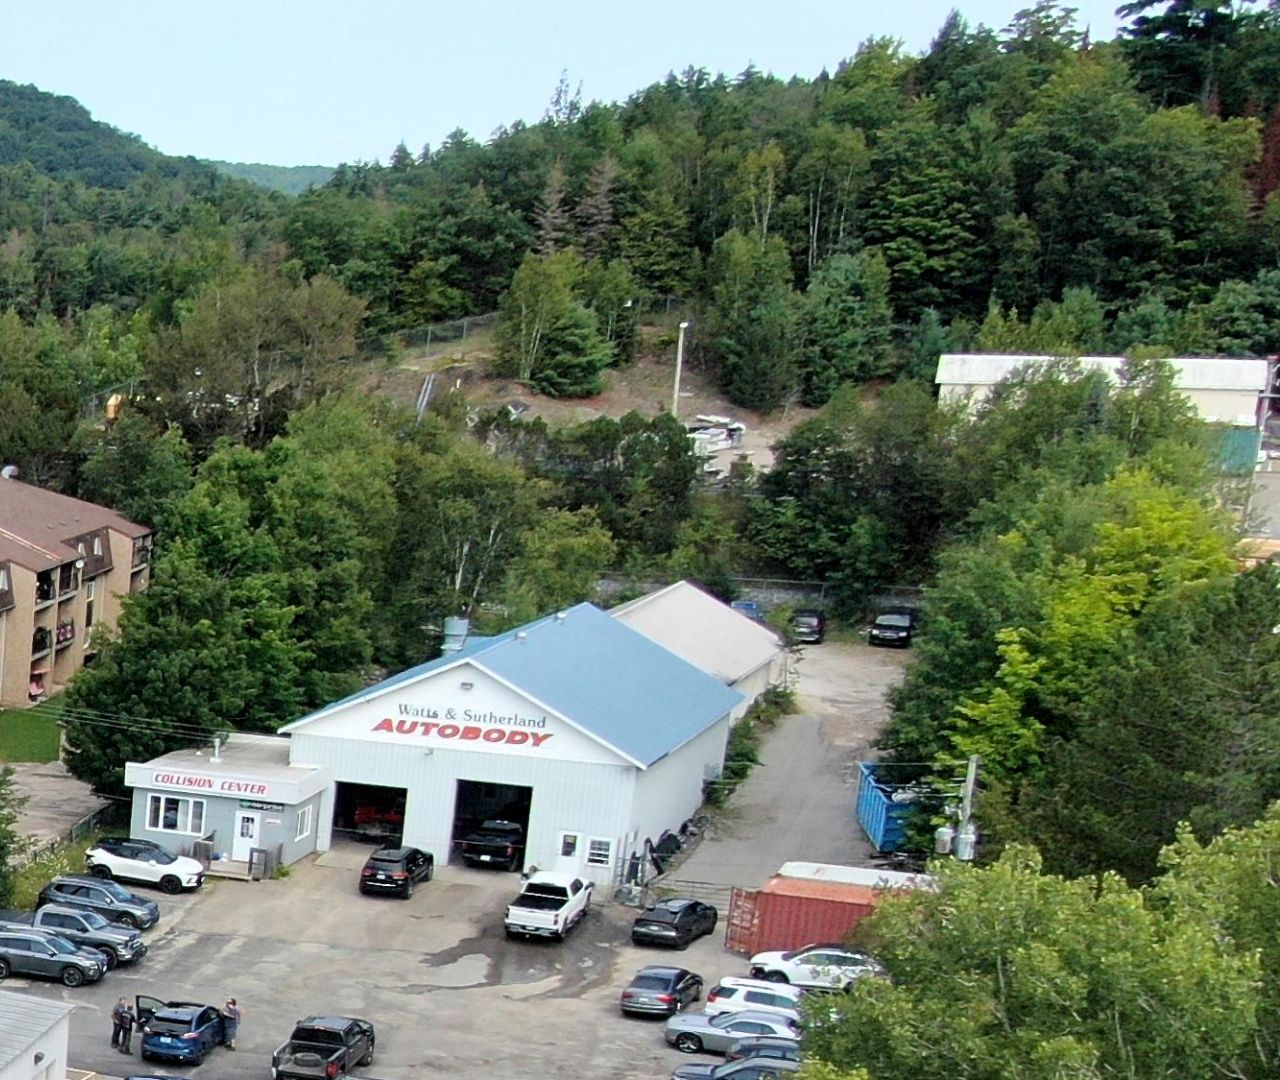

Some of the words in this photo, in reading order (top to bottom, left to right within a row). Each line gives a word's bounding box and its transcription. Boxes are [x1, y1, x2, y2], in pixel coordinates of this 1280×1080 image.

[398, 703, 439, 719] Watts
[445, 707, 457, 720] &
[463, 709, 547, 729] Sutherland
[370, 718, 555, 747] AUTOBODY
[154, 773, 214, 789] COLLISION
[220, 780, 266, 795] CENTER
